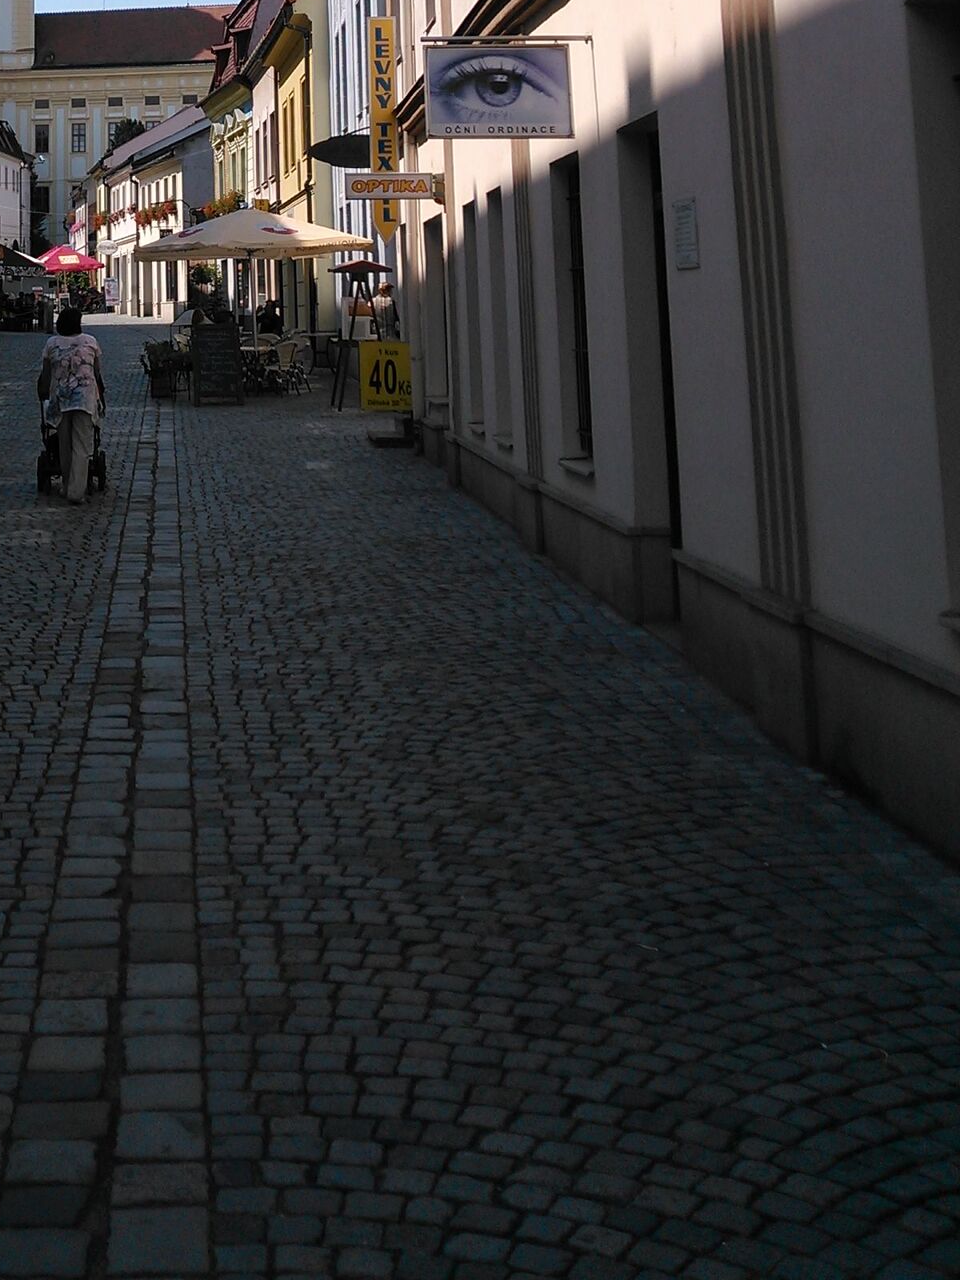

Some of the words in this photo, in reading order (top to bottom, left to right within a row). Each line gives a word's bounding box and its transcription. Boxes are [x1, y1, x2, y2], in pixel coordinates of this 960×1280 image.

[375, 27, 392, 109] LEVNÝ
[444, 124, 477, 135] OČNÍ
[487, 124, 557, 135] ORDINACE
[351, 178, 429, 194] OPTIKA
[375, 122, 397, 223] TEXL
[369, 359, 396, 394] 40
[398, 380, 412, 396] Kč
